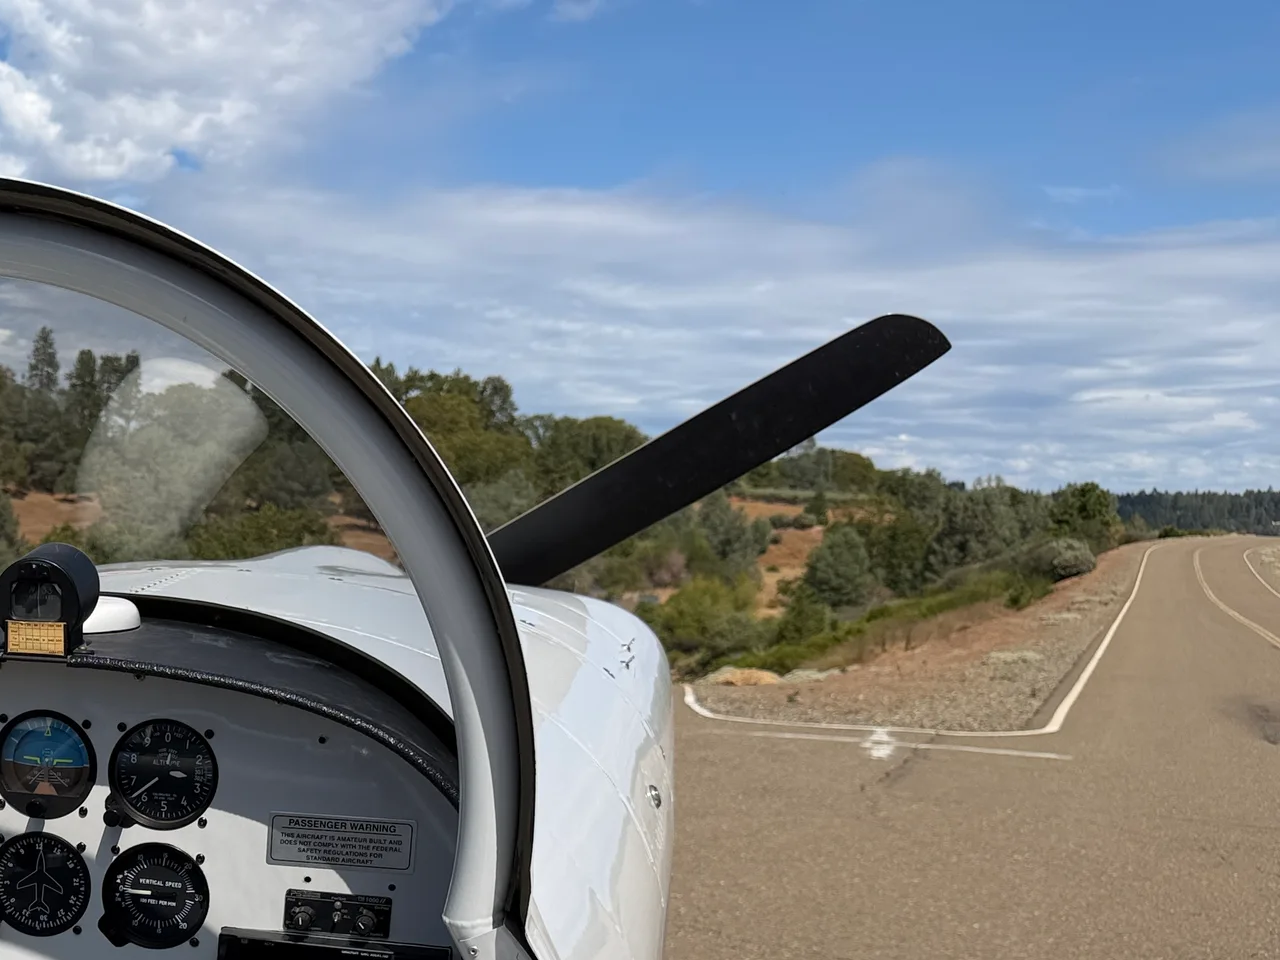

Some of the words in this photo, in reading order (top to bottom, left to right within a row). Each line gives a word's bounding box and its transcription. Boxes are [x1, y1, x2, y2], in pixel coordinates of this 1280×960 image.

[144, 737, 151, 747] 9
[165, 733, 171, 742] 0
[130, 754, 137, 764] 8
[196, 755, 202, 764] 2
[131, 776, 136, 786] 7
[194, 783, 200, 793] 3
[141, 792, 148, 802] 6
[181, 796, 187, 806] 4
[161, 801, 167, 811] 5
[288, 818, 347, 830] PASSENGER
[350, 822, 396, 833] WARNING
[296, 833, 328, 841] AIRCRAFT
[53, 847, 61, 855] 15
[313, 841, 339, 849] COMPLY
[372, 845, 402, 853] FEDERAL
[323, 849, 368, 857] REGULATIONS
[67, 860, 75, 869] 18
[306, 855, 340, 863] STANDARD
[341, 857, 373, 865] AIRCRAFT
[73, 878, 79, 886] 21
[140, 878, 164, 886] VERTICAL
[69, 896, 77, 904] 24
[22, 909, 30, 917] 33
[57, 909, 65, 917] 27
[179, 922, 187, 930] 20
